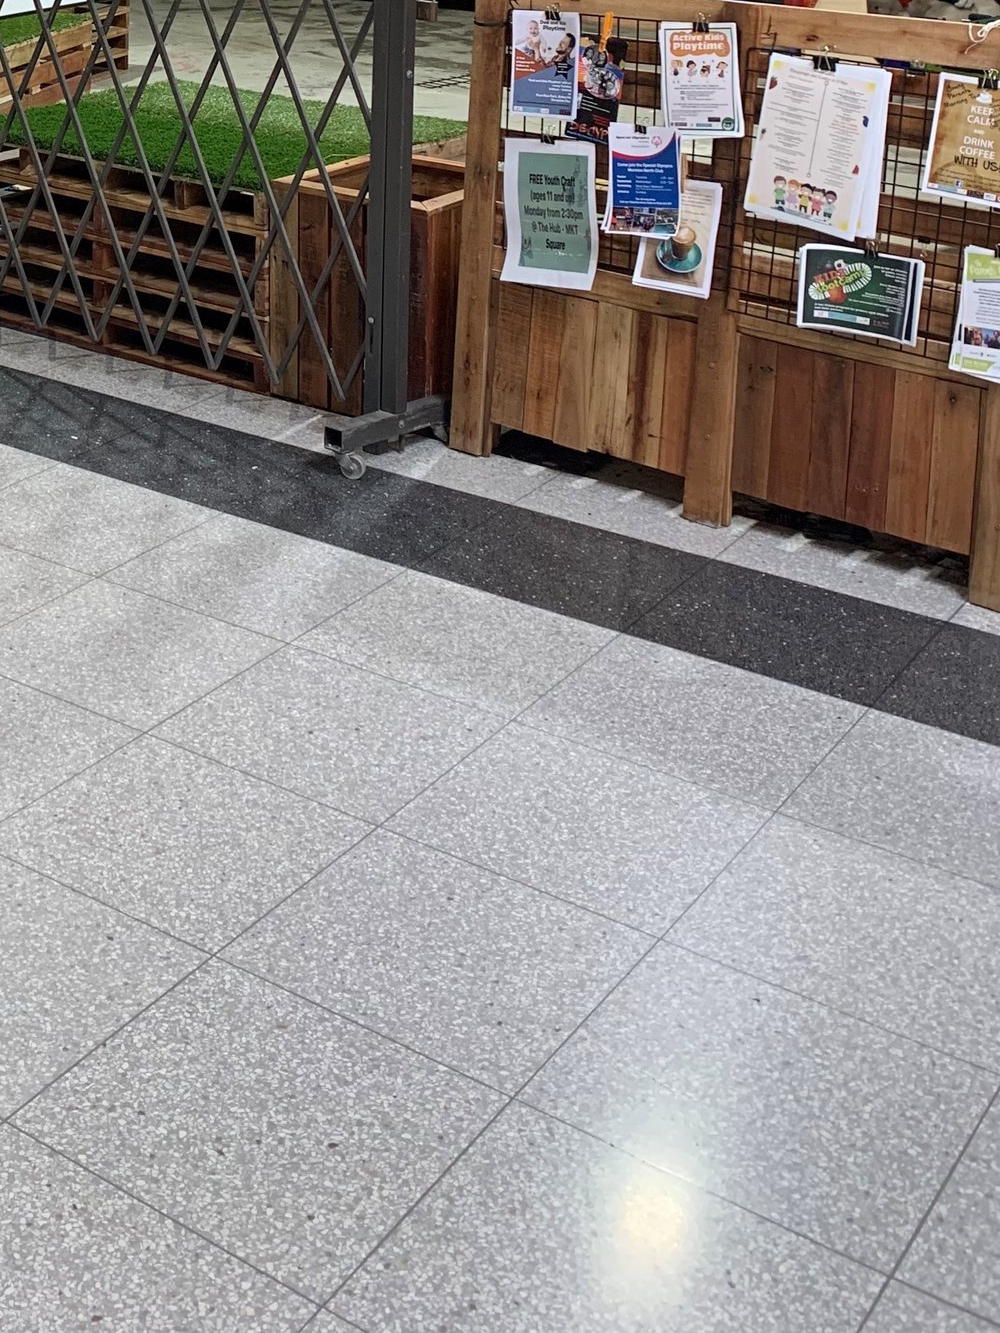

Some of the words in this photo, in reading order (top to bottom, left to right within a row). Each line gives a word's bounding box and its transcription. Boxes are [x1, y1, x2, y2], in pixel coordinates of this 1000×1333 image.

[673, 42, 724, 51] Playtime
[970, 105, 995, 116] KEEP
[963, 135, 995, 150] DRINK
[959, 146, 996, 160] COFFEE
[953, 154, 979, 168] WITH
[529, 174, 543, 185] FREE
[544, 175, 560, 186] Youth
[530, 192, 546, 203] (ages
[547, 192, 553, 200] 11
[554, 193, 564, 202] and
[524, 206, 546, 220] Monday
[547, 208, 560, 218] from
[561, 208, 583, 221] 2:30pm
[538, 222, 548, 233] The
[549, 223, 561, 233] Hub
[546, 238, 565, 250] Square
